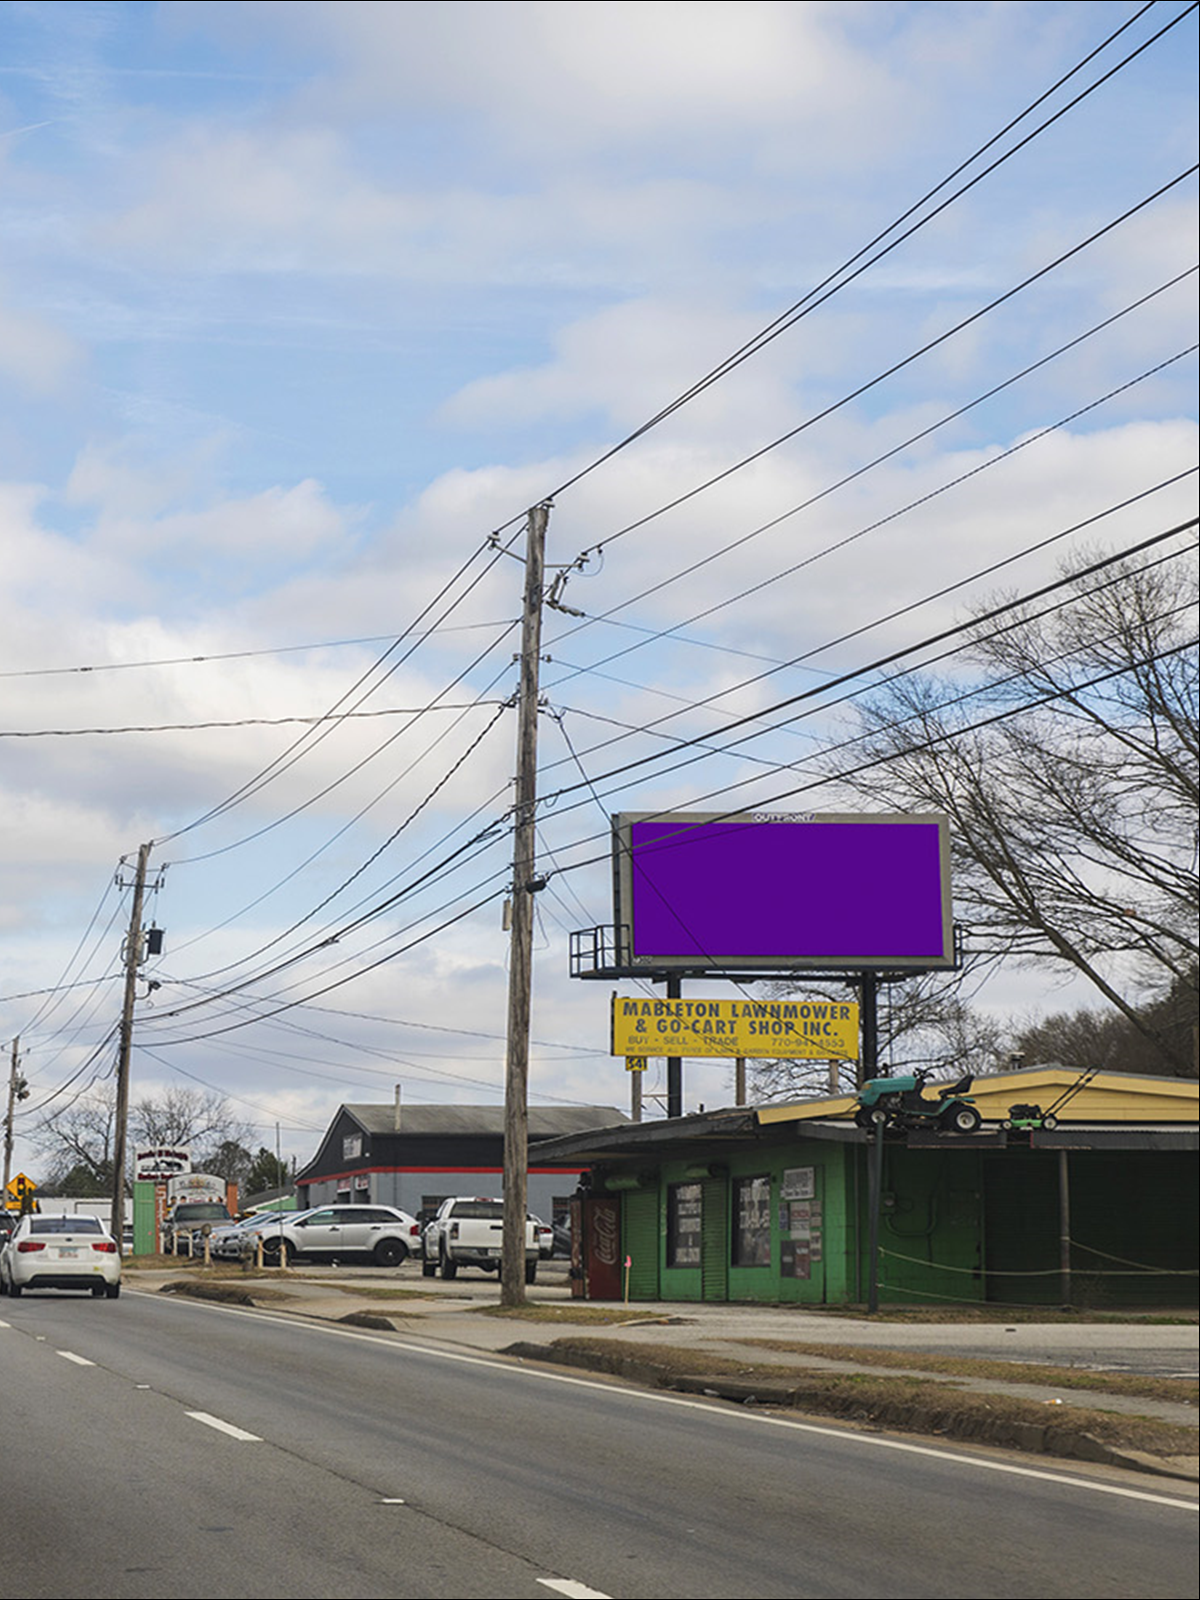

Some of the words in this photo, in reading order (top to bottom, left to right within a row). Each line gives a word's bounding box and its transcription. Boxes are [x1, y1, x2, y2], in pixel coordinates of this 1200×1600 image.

[623, 1002, 720, 1017] MABLETON
[731, 1004, 850, 1020] LAWNMOWER
[635, 1018, 647, 1033] &
[656, 1019, 737, 1034] GO-CART
[749, 1020, 795, 1035] SHOP
[803, 1022, 838, 1036] INC.
[628, 1036, 649, 1045] BUY
[663, 1037, 689, 1045] SELL
[704, 1036, 739, 1046] TRADE
